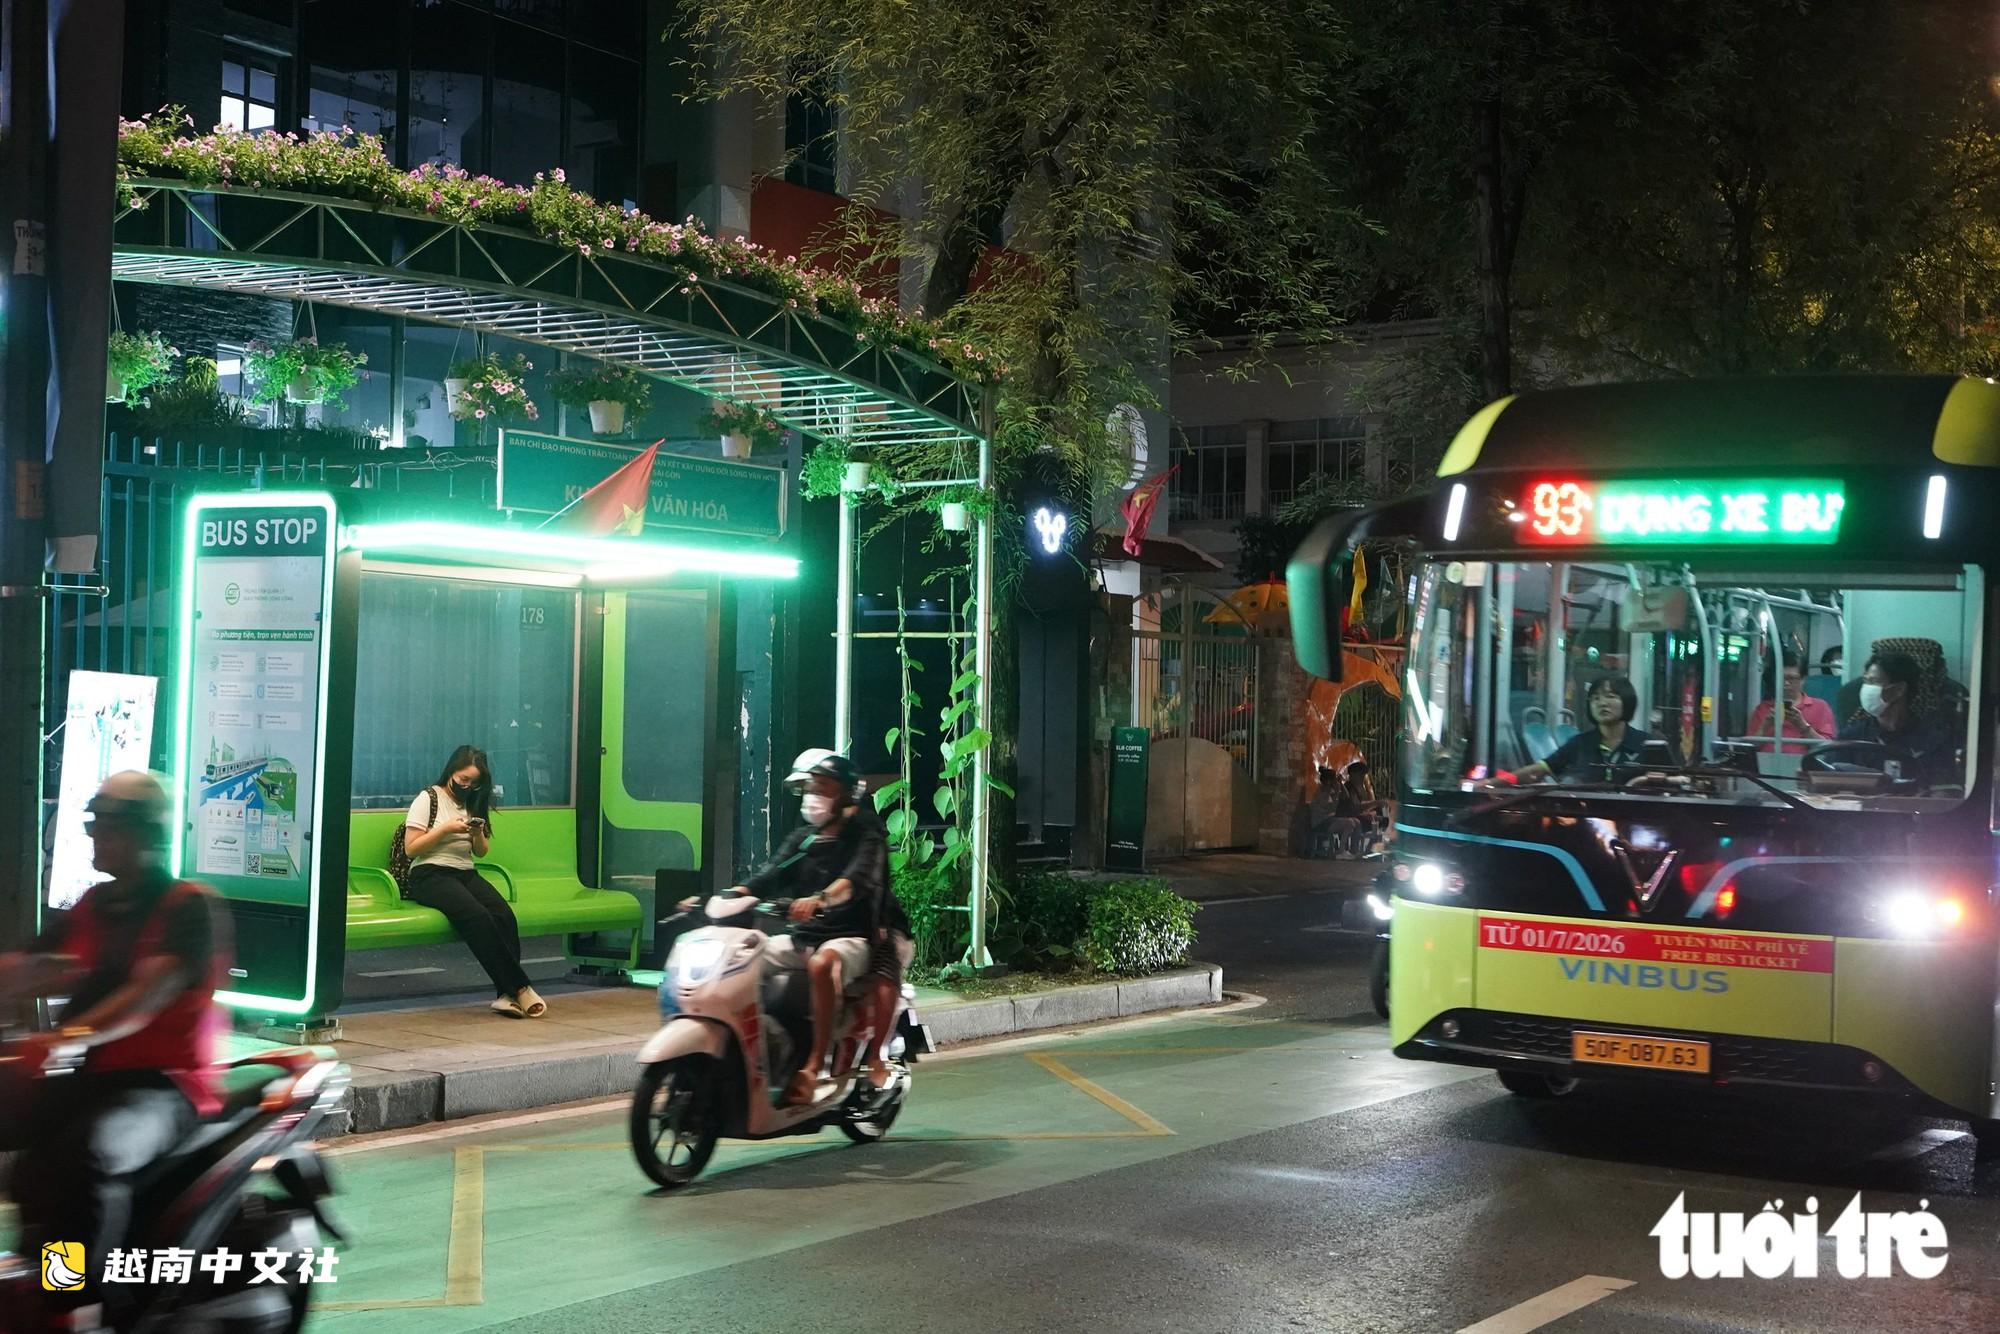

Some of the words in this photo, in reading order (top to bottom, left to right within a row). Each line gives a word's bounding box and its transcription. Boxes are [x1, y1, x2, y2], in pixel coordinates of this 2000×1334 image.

[509, 437, 526, 447] BAN
[560, 445, 587, 456] PHONG
[652, 494, 688, 516] VĂN
[692, 499, 728, 521] HÓA
[1533, 483, 1583, 535] 93
[1720, 494, 1769, 532] XE
[202, 519, 248, 547] BUS
[254, 517, 318, 546] STOP
[522, 607, 544, 624] 178
[1484, 921, 1521, 946] TỪ
[1521, 928, 1626, 954] 01/7/2026
[1755, 940, 1783, 953] PHÍ
[1787, 941, 1810, 955] VÉ
[1661, 949, 1702, 962] FREE
[1705, 952, 1736, 964] BUS
[1738, 954, 1800, 969] TICKET
[1558, 957, 1730, 994] VINBUS
[1585, 1039, 1697, 1066] 50F-087.63
